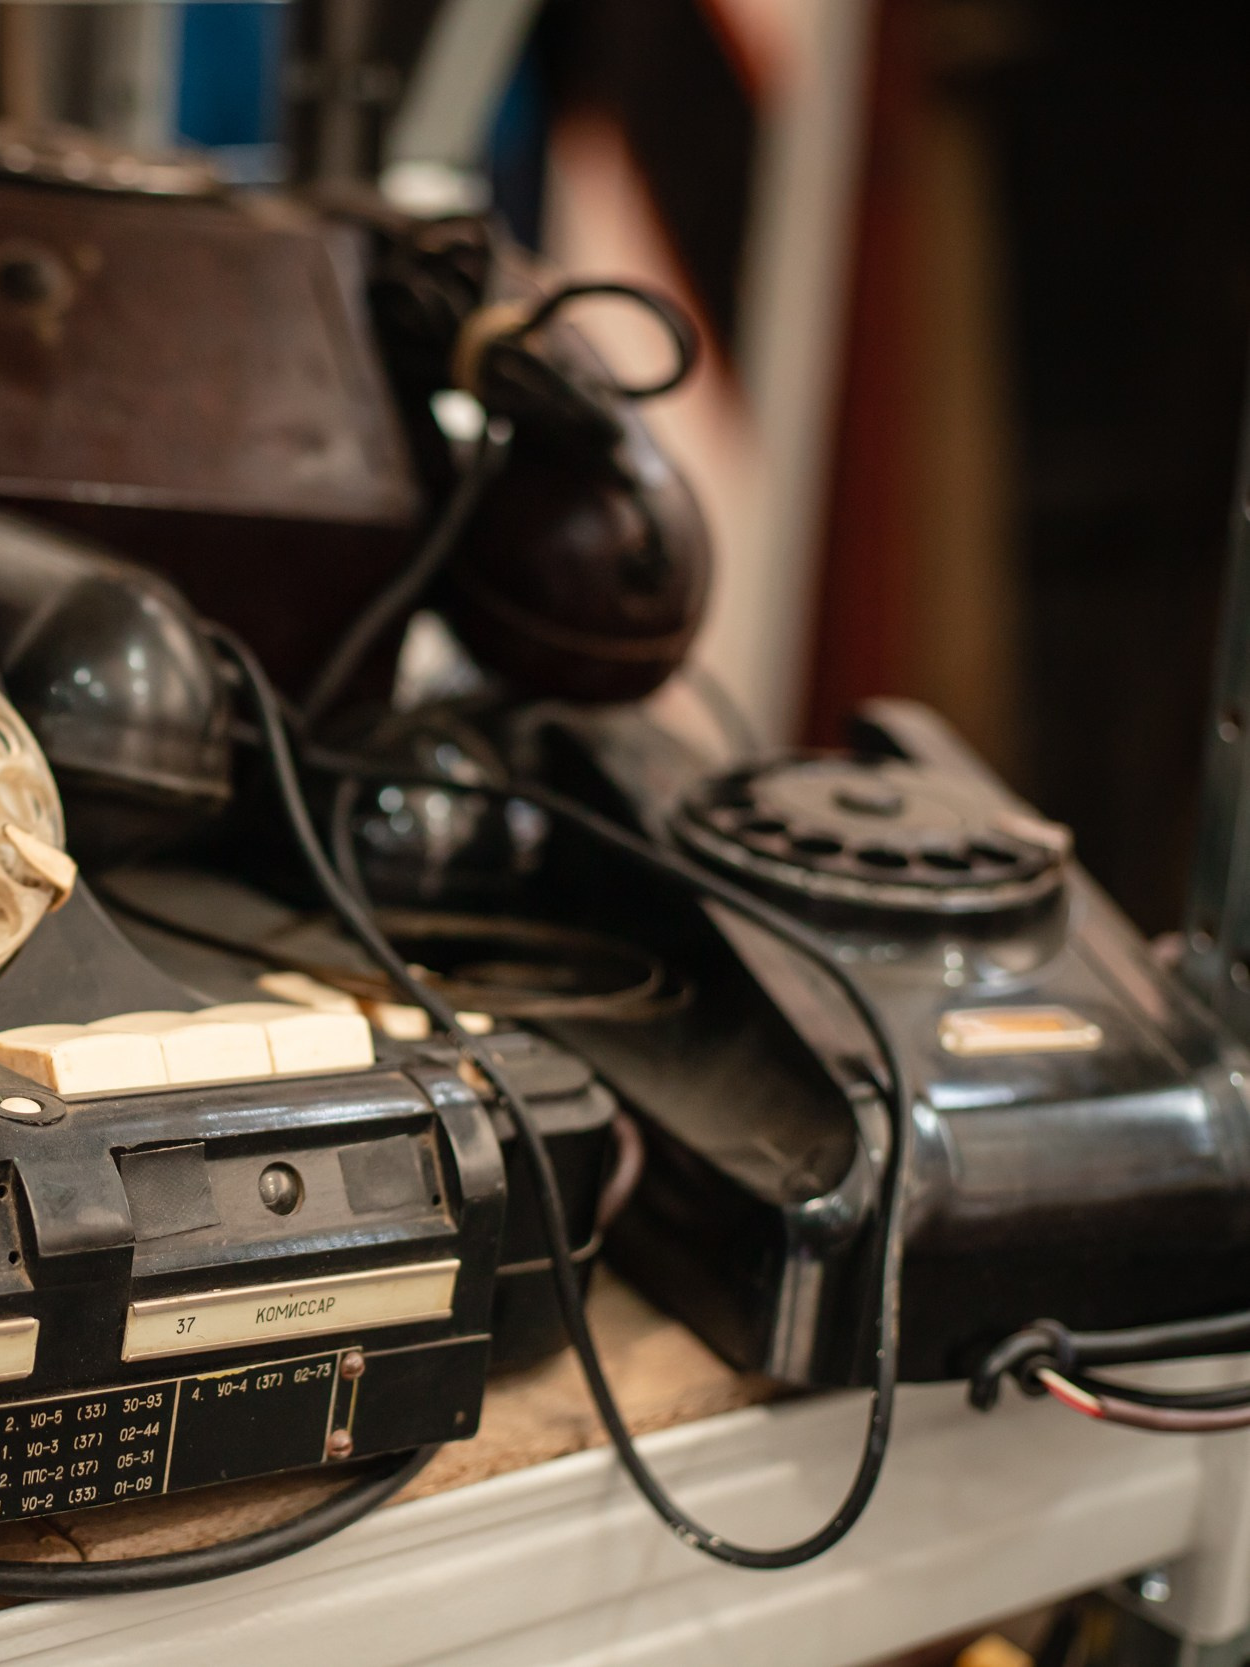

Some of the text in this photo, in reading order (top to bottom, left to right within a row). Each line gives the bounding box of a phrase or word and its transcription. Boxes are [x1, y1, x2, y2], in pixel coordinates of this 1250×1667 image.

[176, 1297, 336, 1334] 37 КОМИССАР
[191, 1362, 332, 1401] 4. УО-4 (37) 02-73
[4, 1393, 163, 1432] 2. УО-5 (33) 30-93
[2, 1422, 160, 1460] 1. УО-3 (37) 02-44
[22, 1466, 64, 1486] ППС-2
[70, 1460, 99, 1477] (37)
[117, 1449, 154, 1469] 05-31
[22, 1493, 54, 1512] УО-2
[68, 1486, 97, 1504] (33)
[114, 1476, 153, 1496] 01-09
